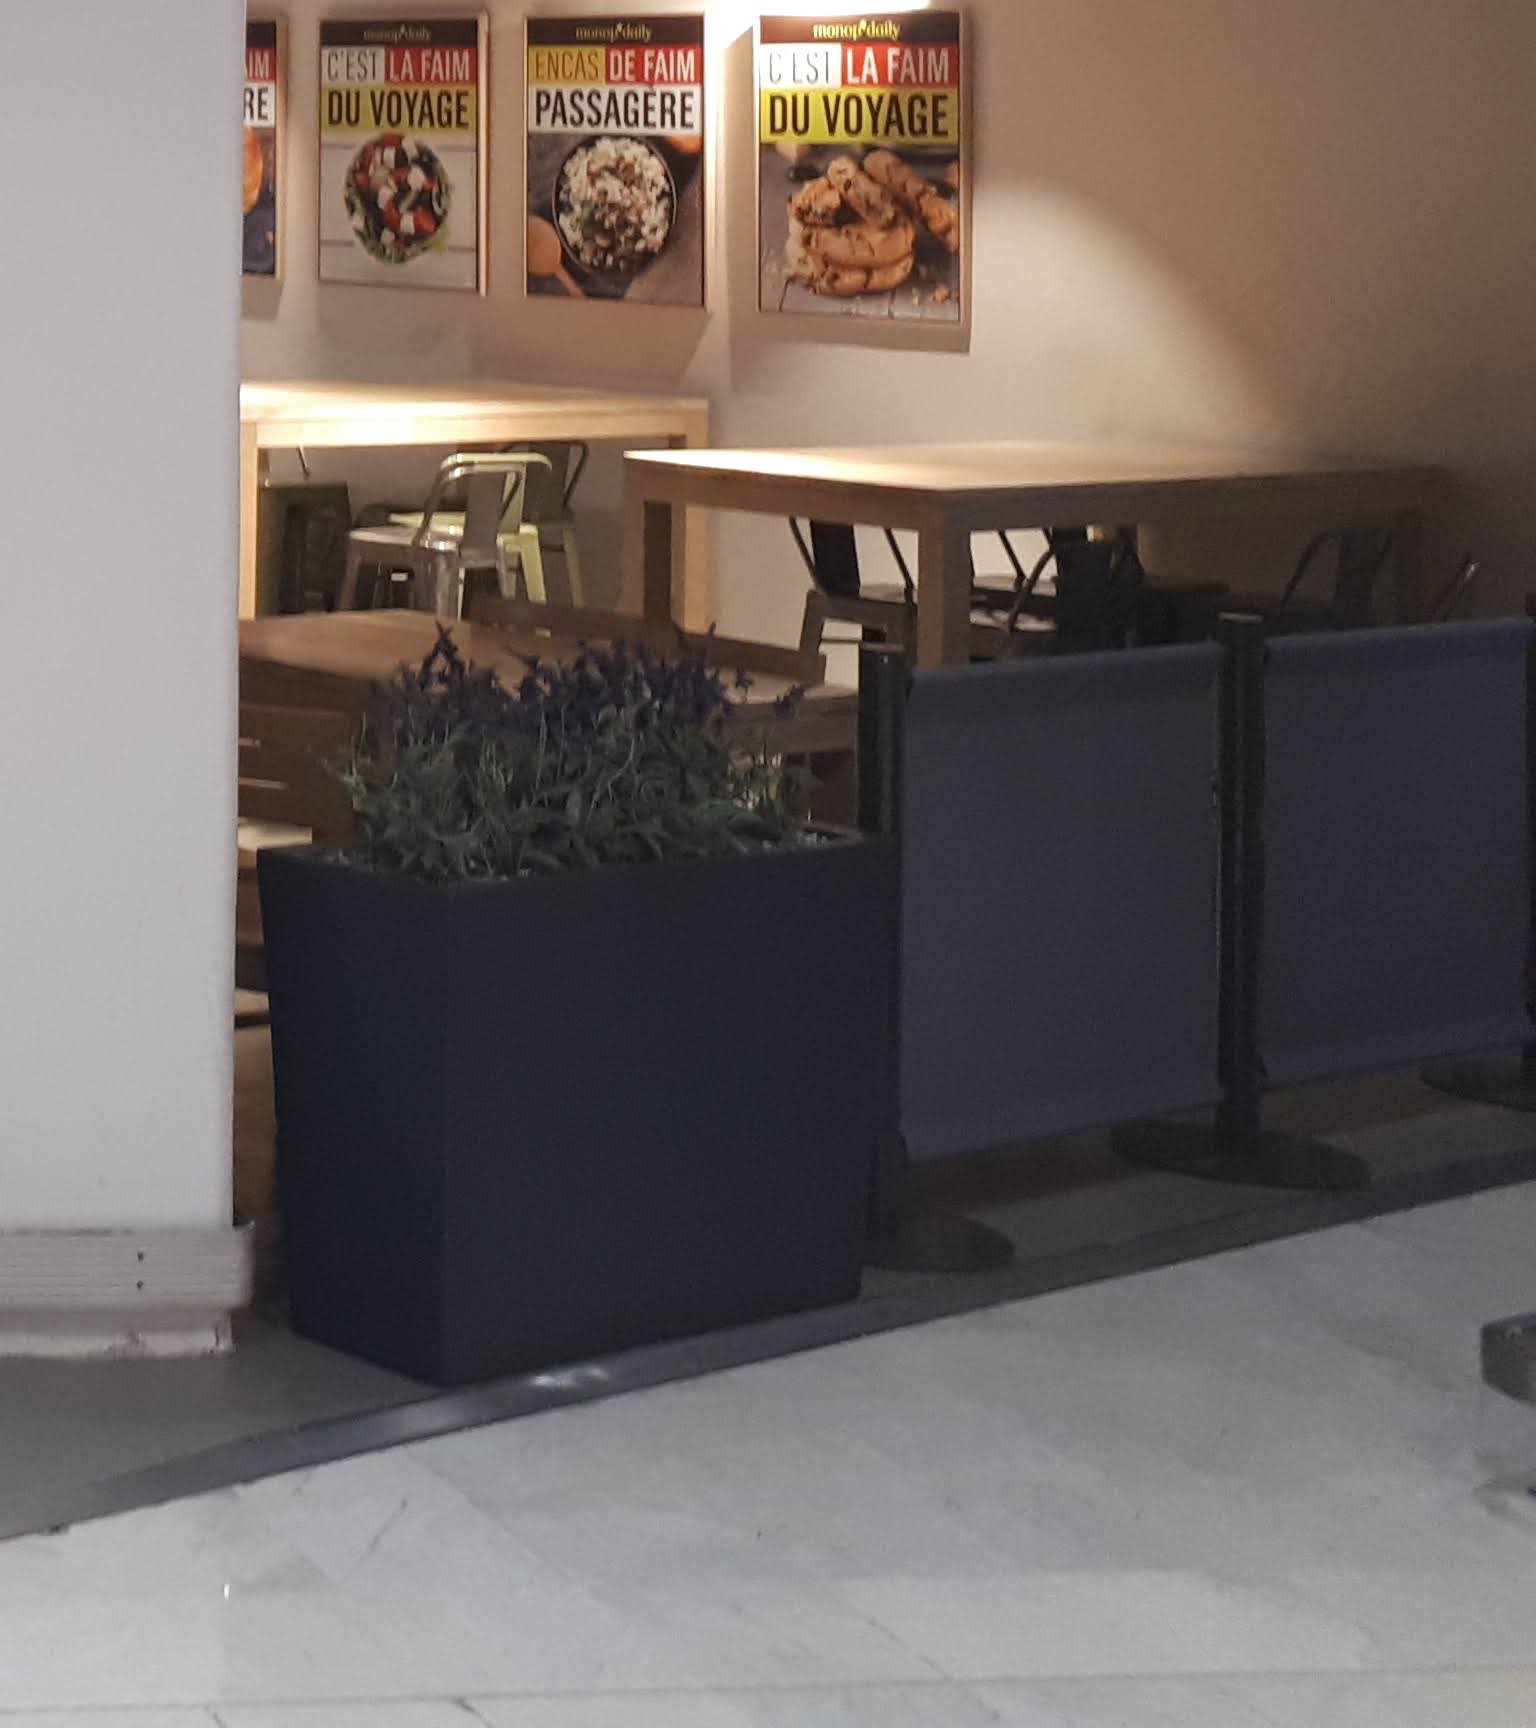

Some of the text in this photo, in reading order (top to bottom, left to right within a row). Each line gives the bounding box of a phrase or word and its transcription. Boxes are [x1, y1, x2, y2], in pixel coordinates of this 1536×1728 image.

[327, 47, 471, 83] C'EST LA FAIM
[535, 48, 695, 83] ENCAS DE FAIM
[768, 46, 949, 85] CEST LA FAIM
[327, 88, 471, 130] DU VOYAGE
[535, 84, 695, 129] PASSAGÈRE
[769, 92, 949, 137] DU VOYAGE
